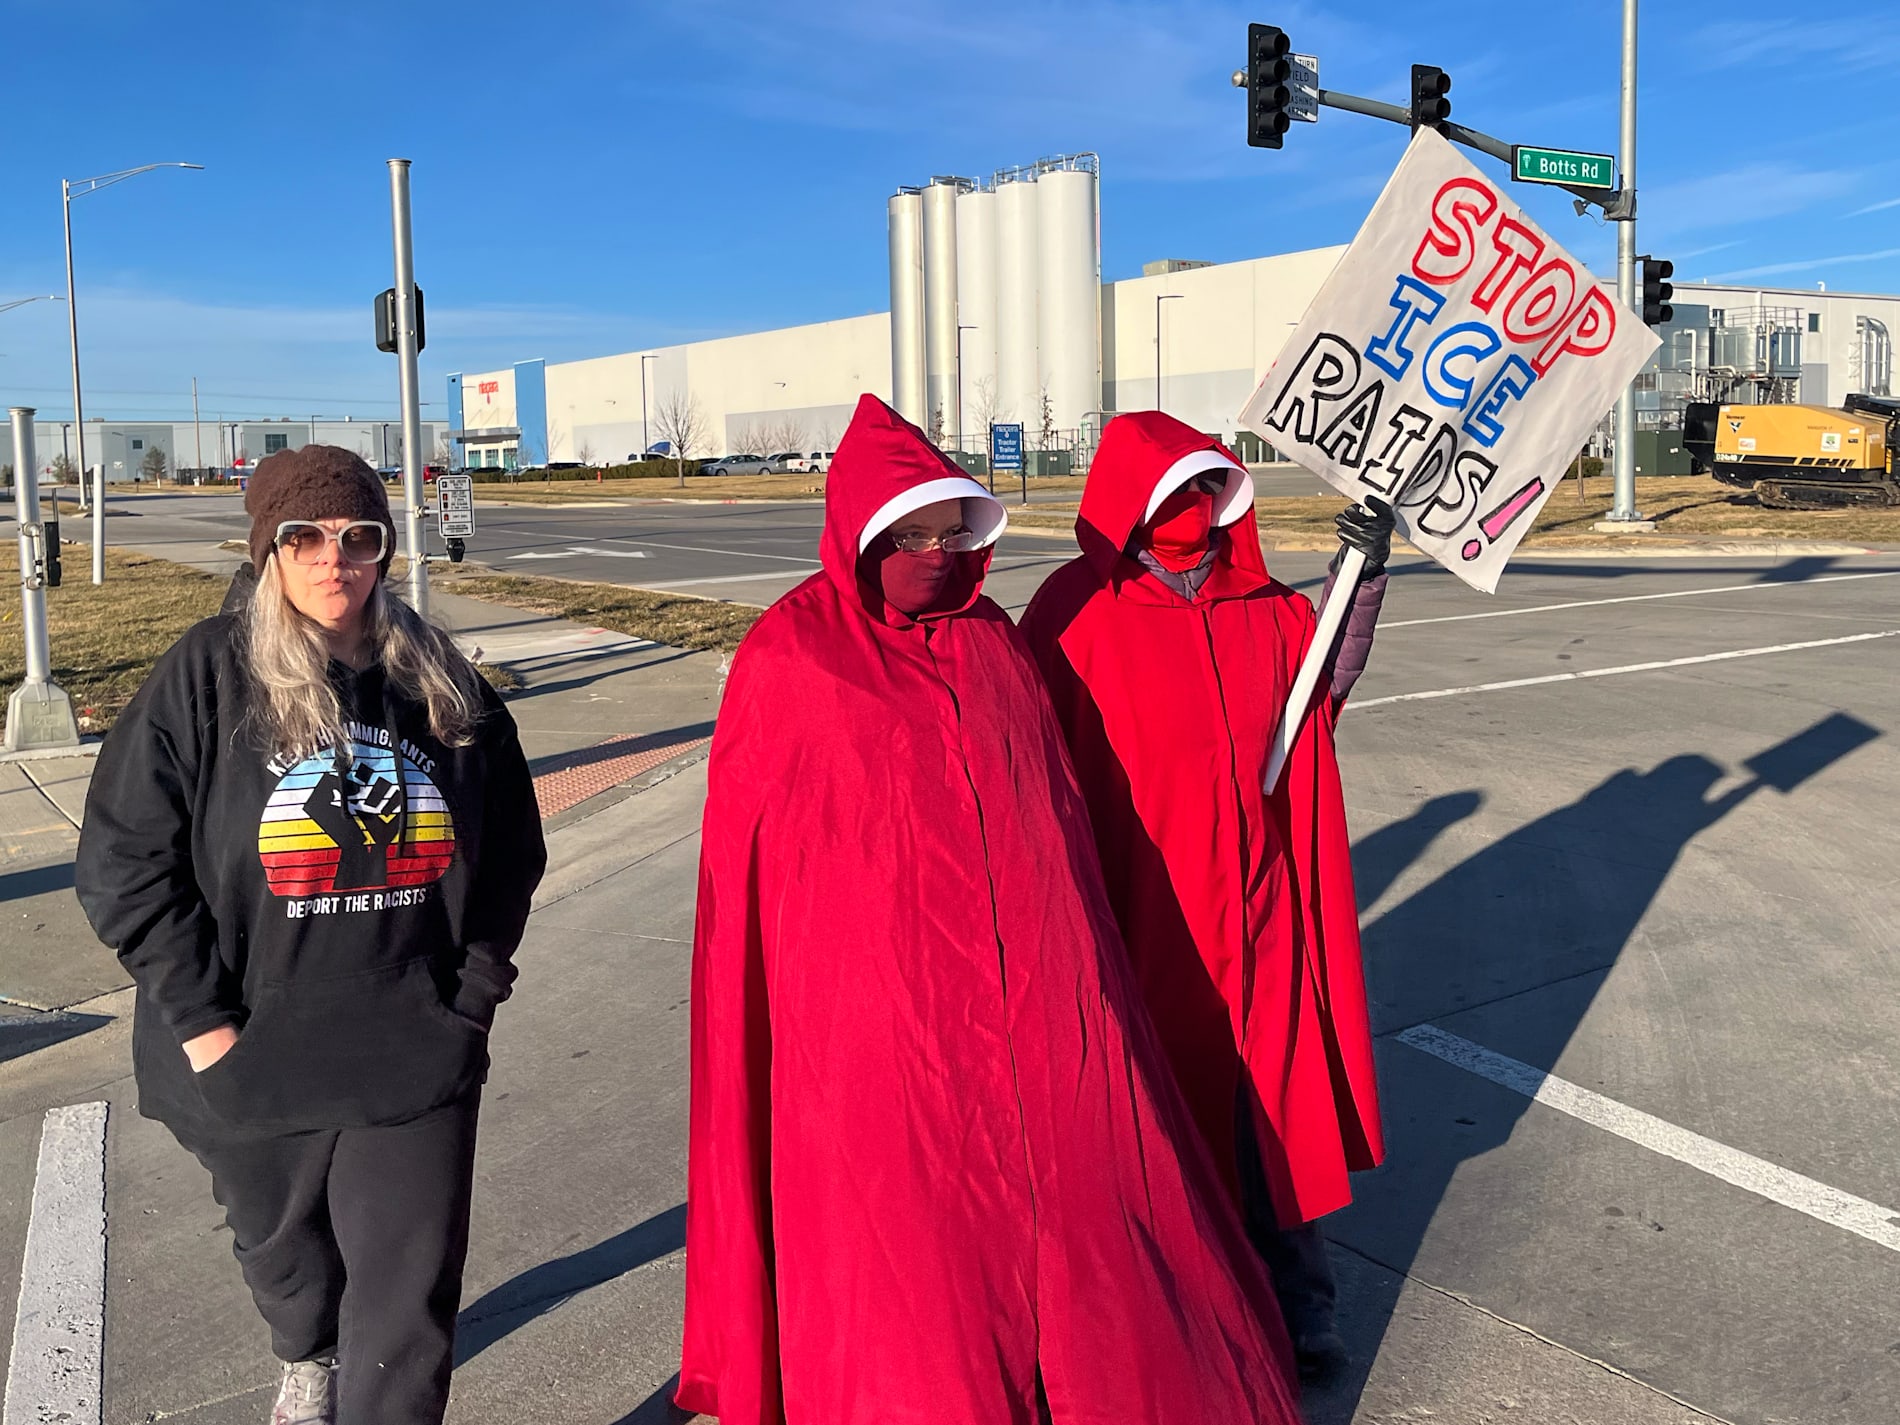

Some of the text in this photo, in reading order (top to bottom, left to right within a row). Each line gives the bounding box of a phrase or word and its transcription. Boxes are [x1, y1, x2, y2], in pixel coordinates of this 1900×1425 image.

[1291, 70, 1310, 82] IELD
[1299, 59, 1315, 69] TURN
[1291, 95, 1313, 106] ASHING
[1540, 157, 1599, 179] Botts Rd
[1412, 177, 1616, 380] STOP
[1364, 274, 1537, 447] ICE
[1264, 332, 1545, 561] RAIDS!
[342, 721, 435, 773] IMMIGANTS
[286, 888, 427, 918] DEPORT THE RACISTS
